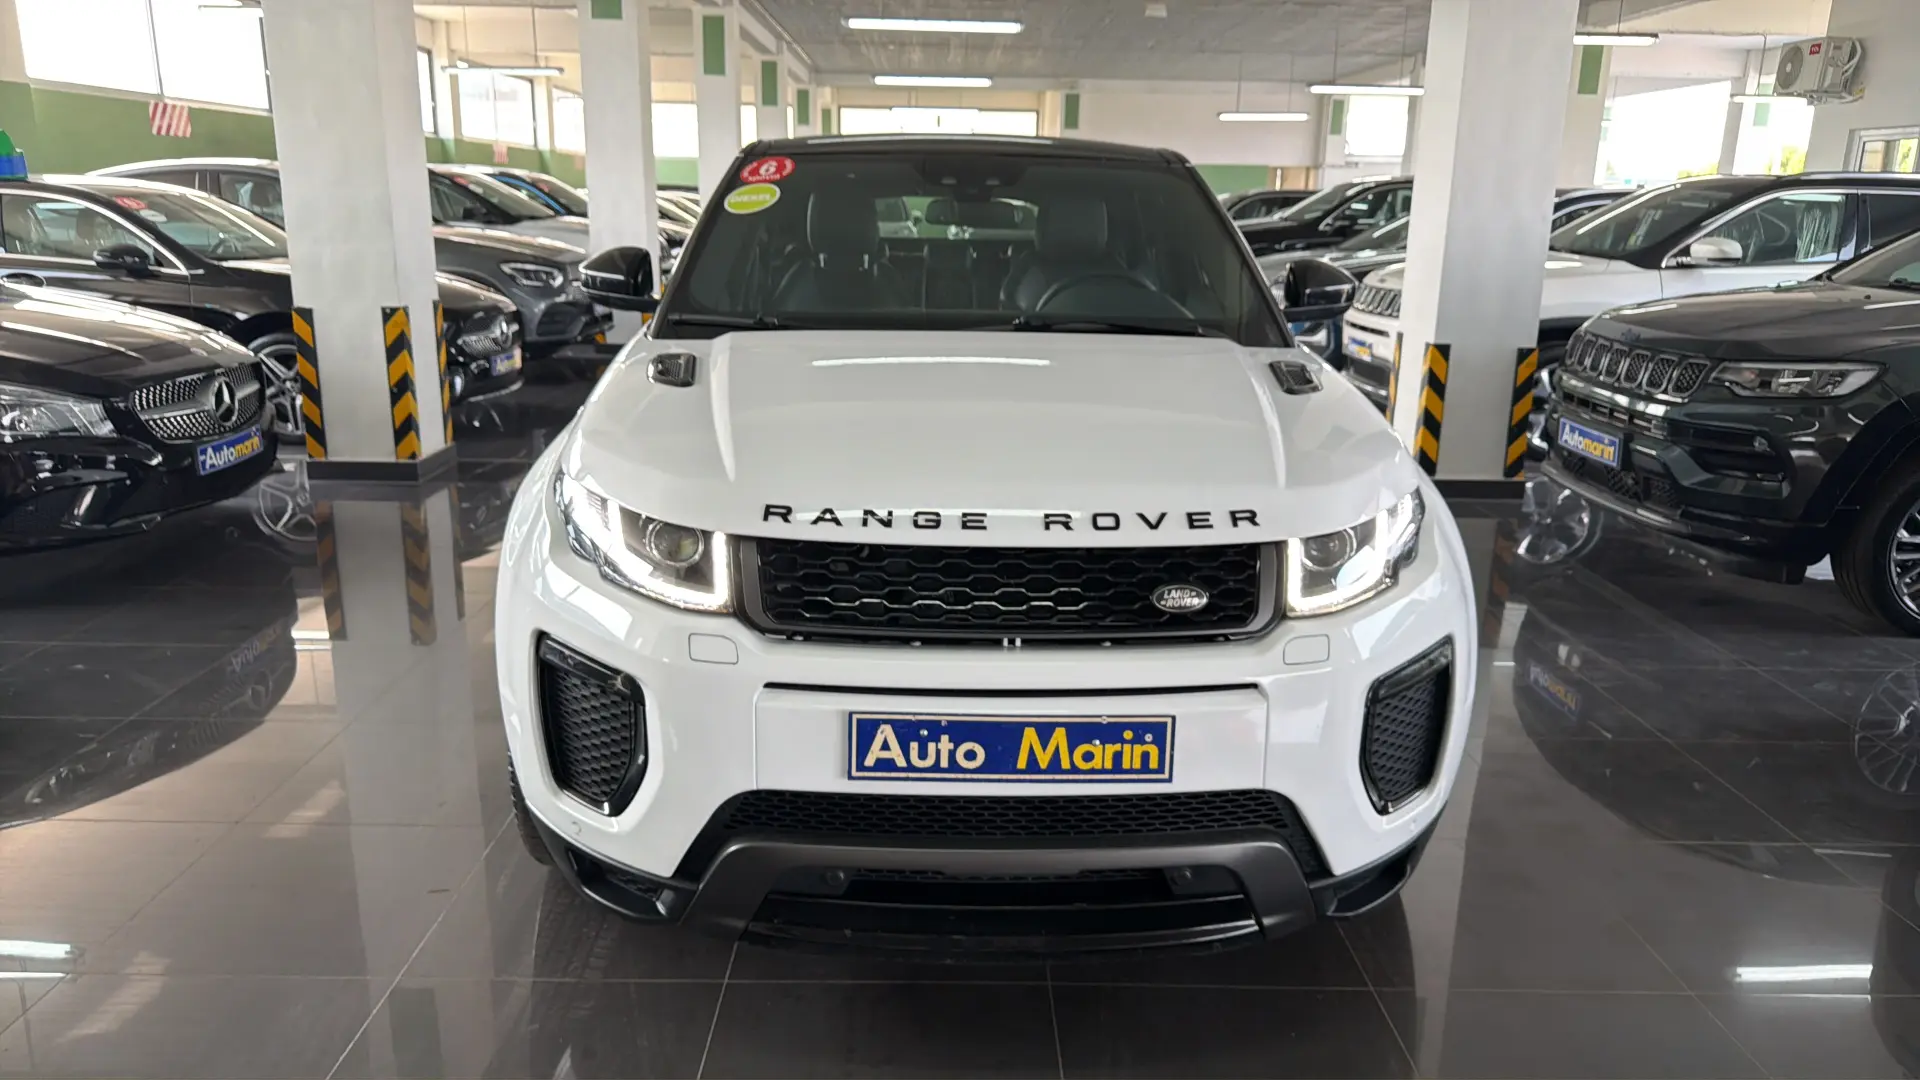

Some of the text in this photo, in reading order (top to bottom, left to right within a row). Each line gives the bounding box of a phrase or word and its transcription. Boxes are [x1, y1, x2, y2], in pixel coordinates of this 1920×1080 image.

[759, 160, 777, 176] 6
[763, 504, 1260, 531] RANGE ROVER
[863, 723, 1158, 770] Auto Marin
